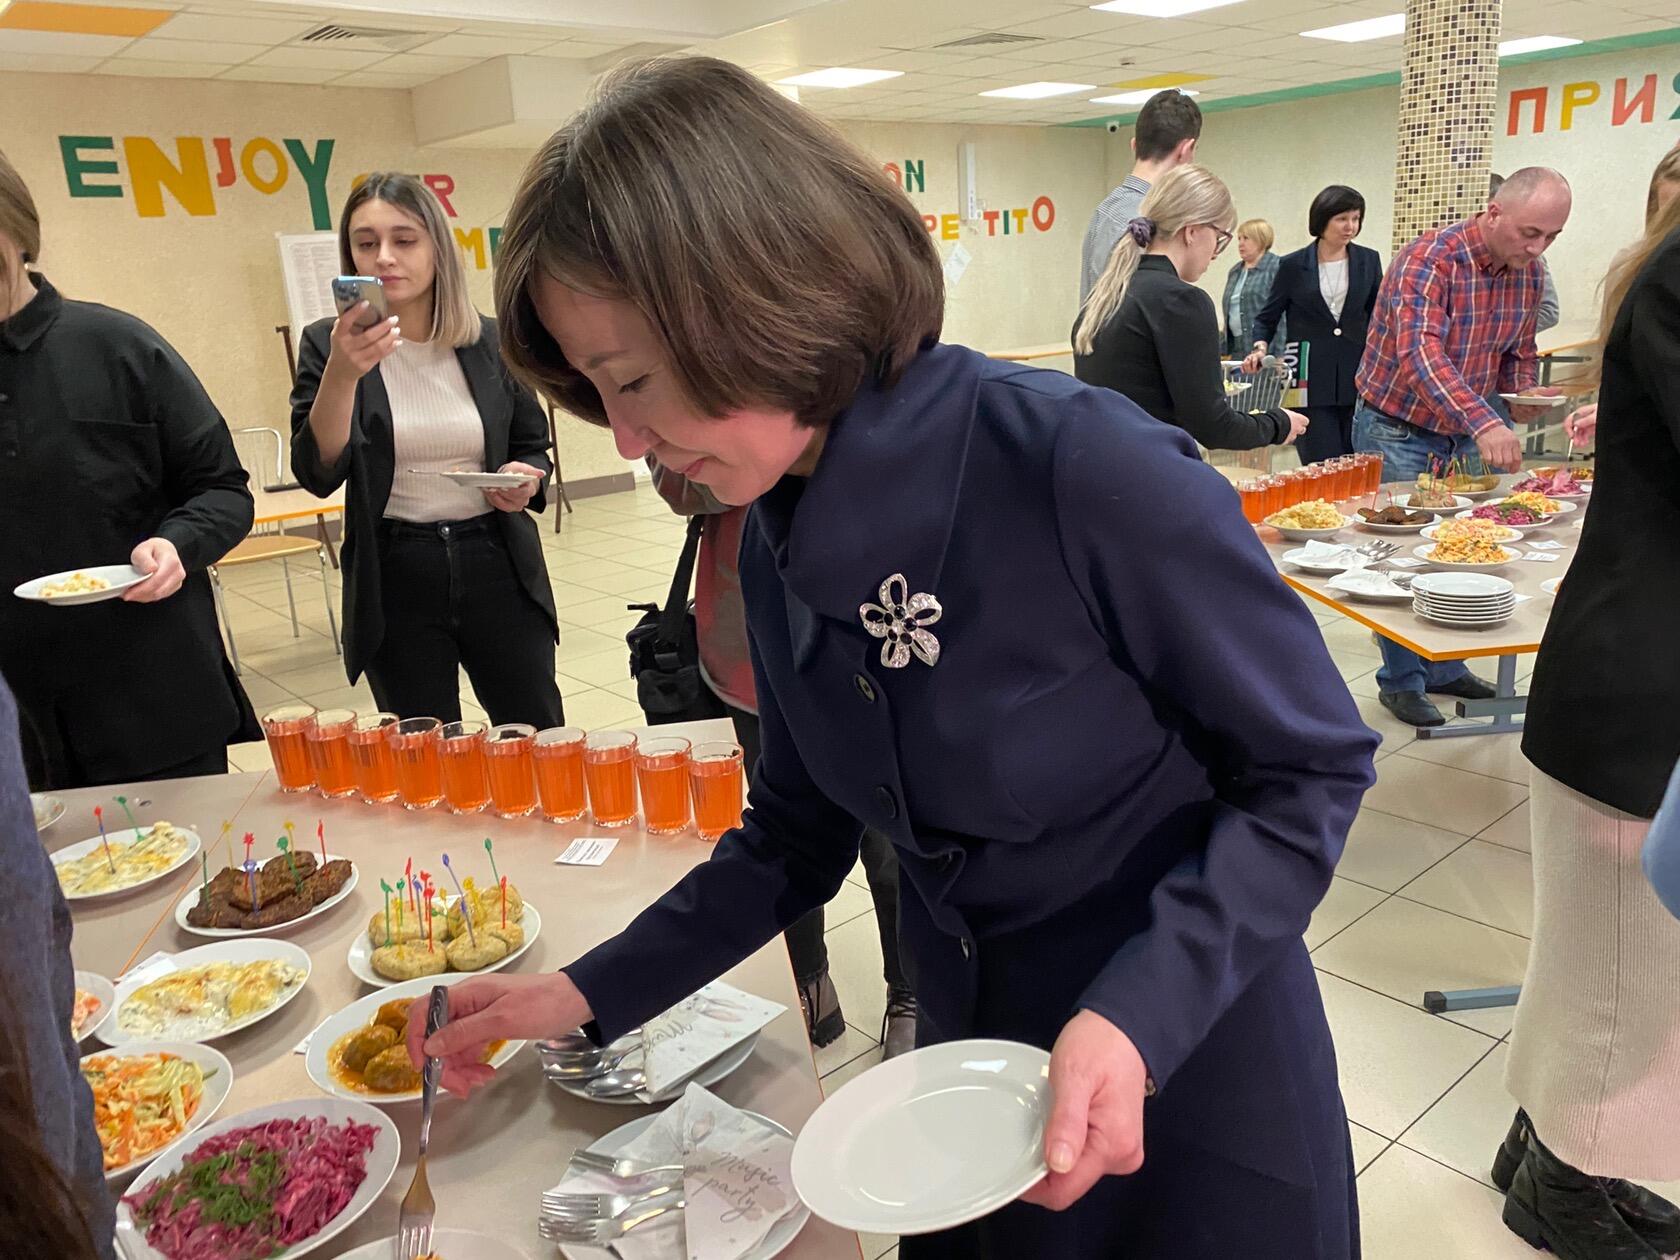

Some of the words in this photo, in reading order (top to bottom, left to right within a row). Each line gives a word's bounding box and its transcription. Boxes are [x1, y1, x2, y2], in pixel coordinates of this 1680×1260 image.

[58, 135, 335, 231] ENJOY
[921, 196, 1055, 240] PETITO
[691, 1178, 759, 1223] party
